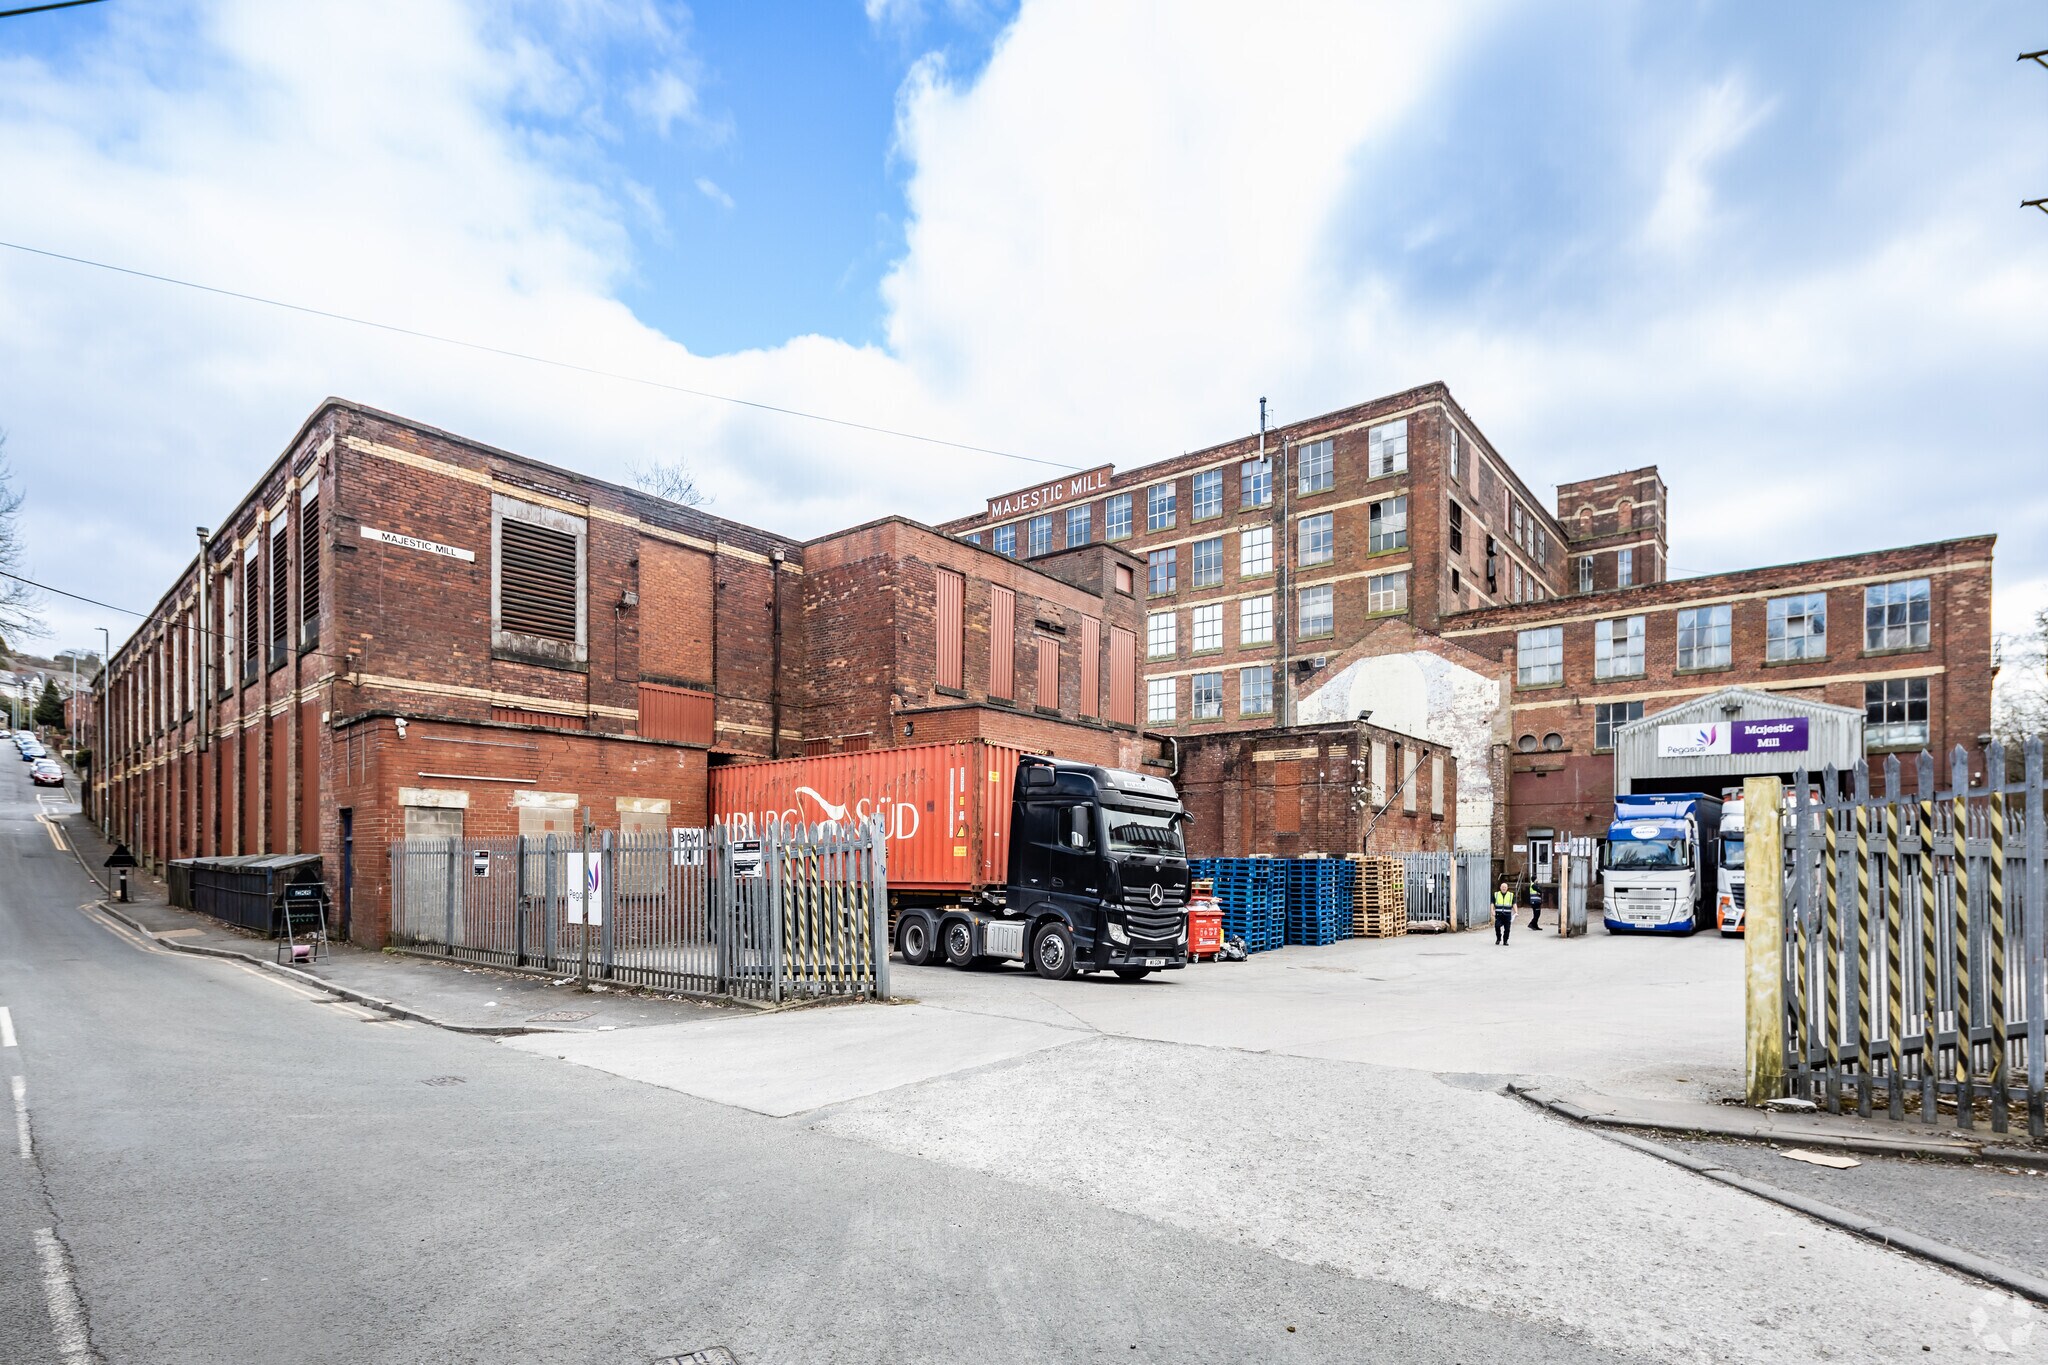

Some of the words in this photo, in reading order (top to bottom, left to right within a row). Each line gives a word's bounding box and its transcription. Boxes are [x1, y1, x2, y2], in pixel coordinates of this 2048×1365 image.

[992, 484, 1063, 518] MAJESTIC
[1071, 472, 1107, 496] MILL
[381, 532, 432, 551] MAJESTIC
[435, 545, 457, 556] MILL
[1744, 723, 1795, 735] Majestic
[1757, 738, 1780, 748] Mill
[1667, 745, 1706, 754] Pegasus
[856, 797, 919, 840] SÜD
[680, 833, 699, 843] BAY
[569, 888, 593, 901] Pegas
